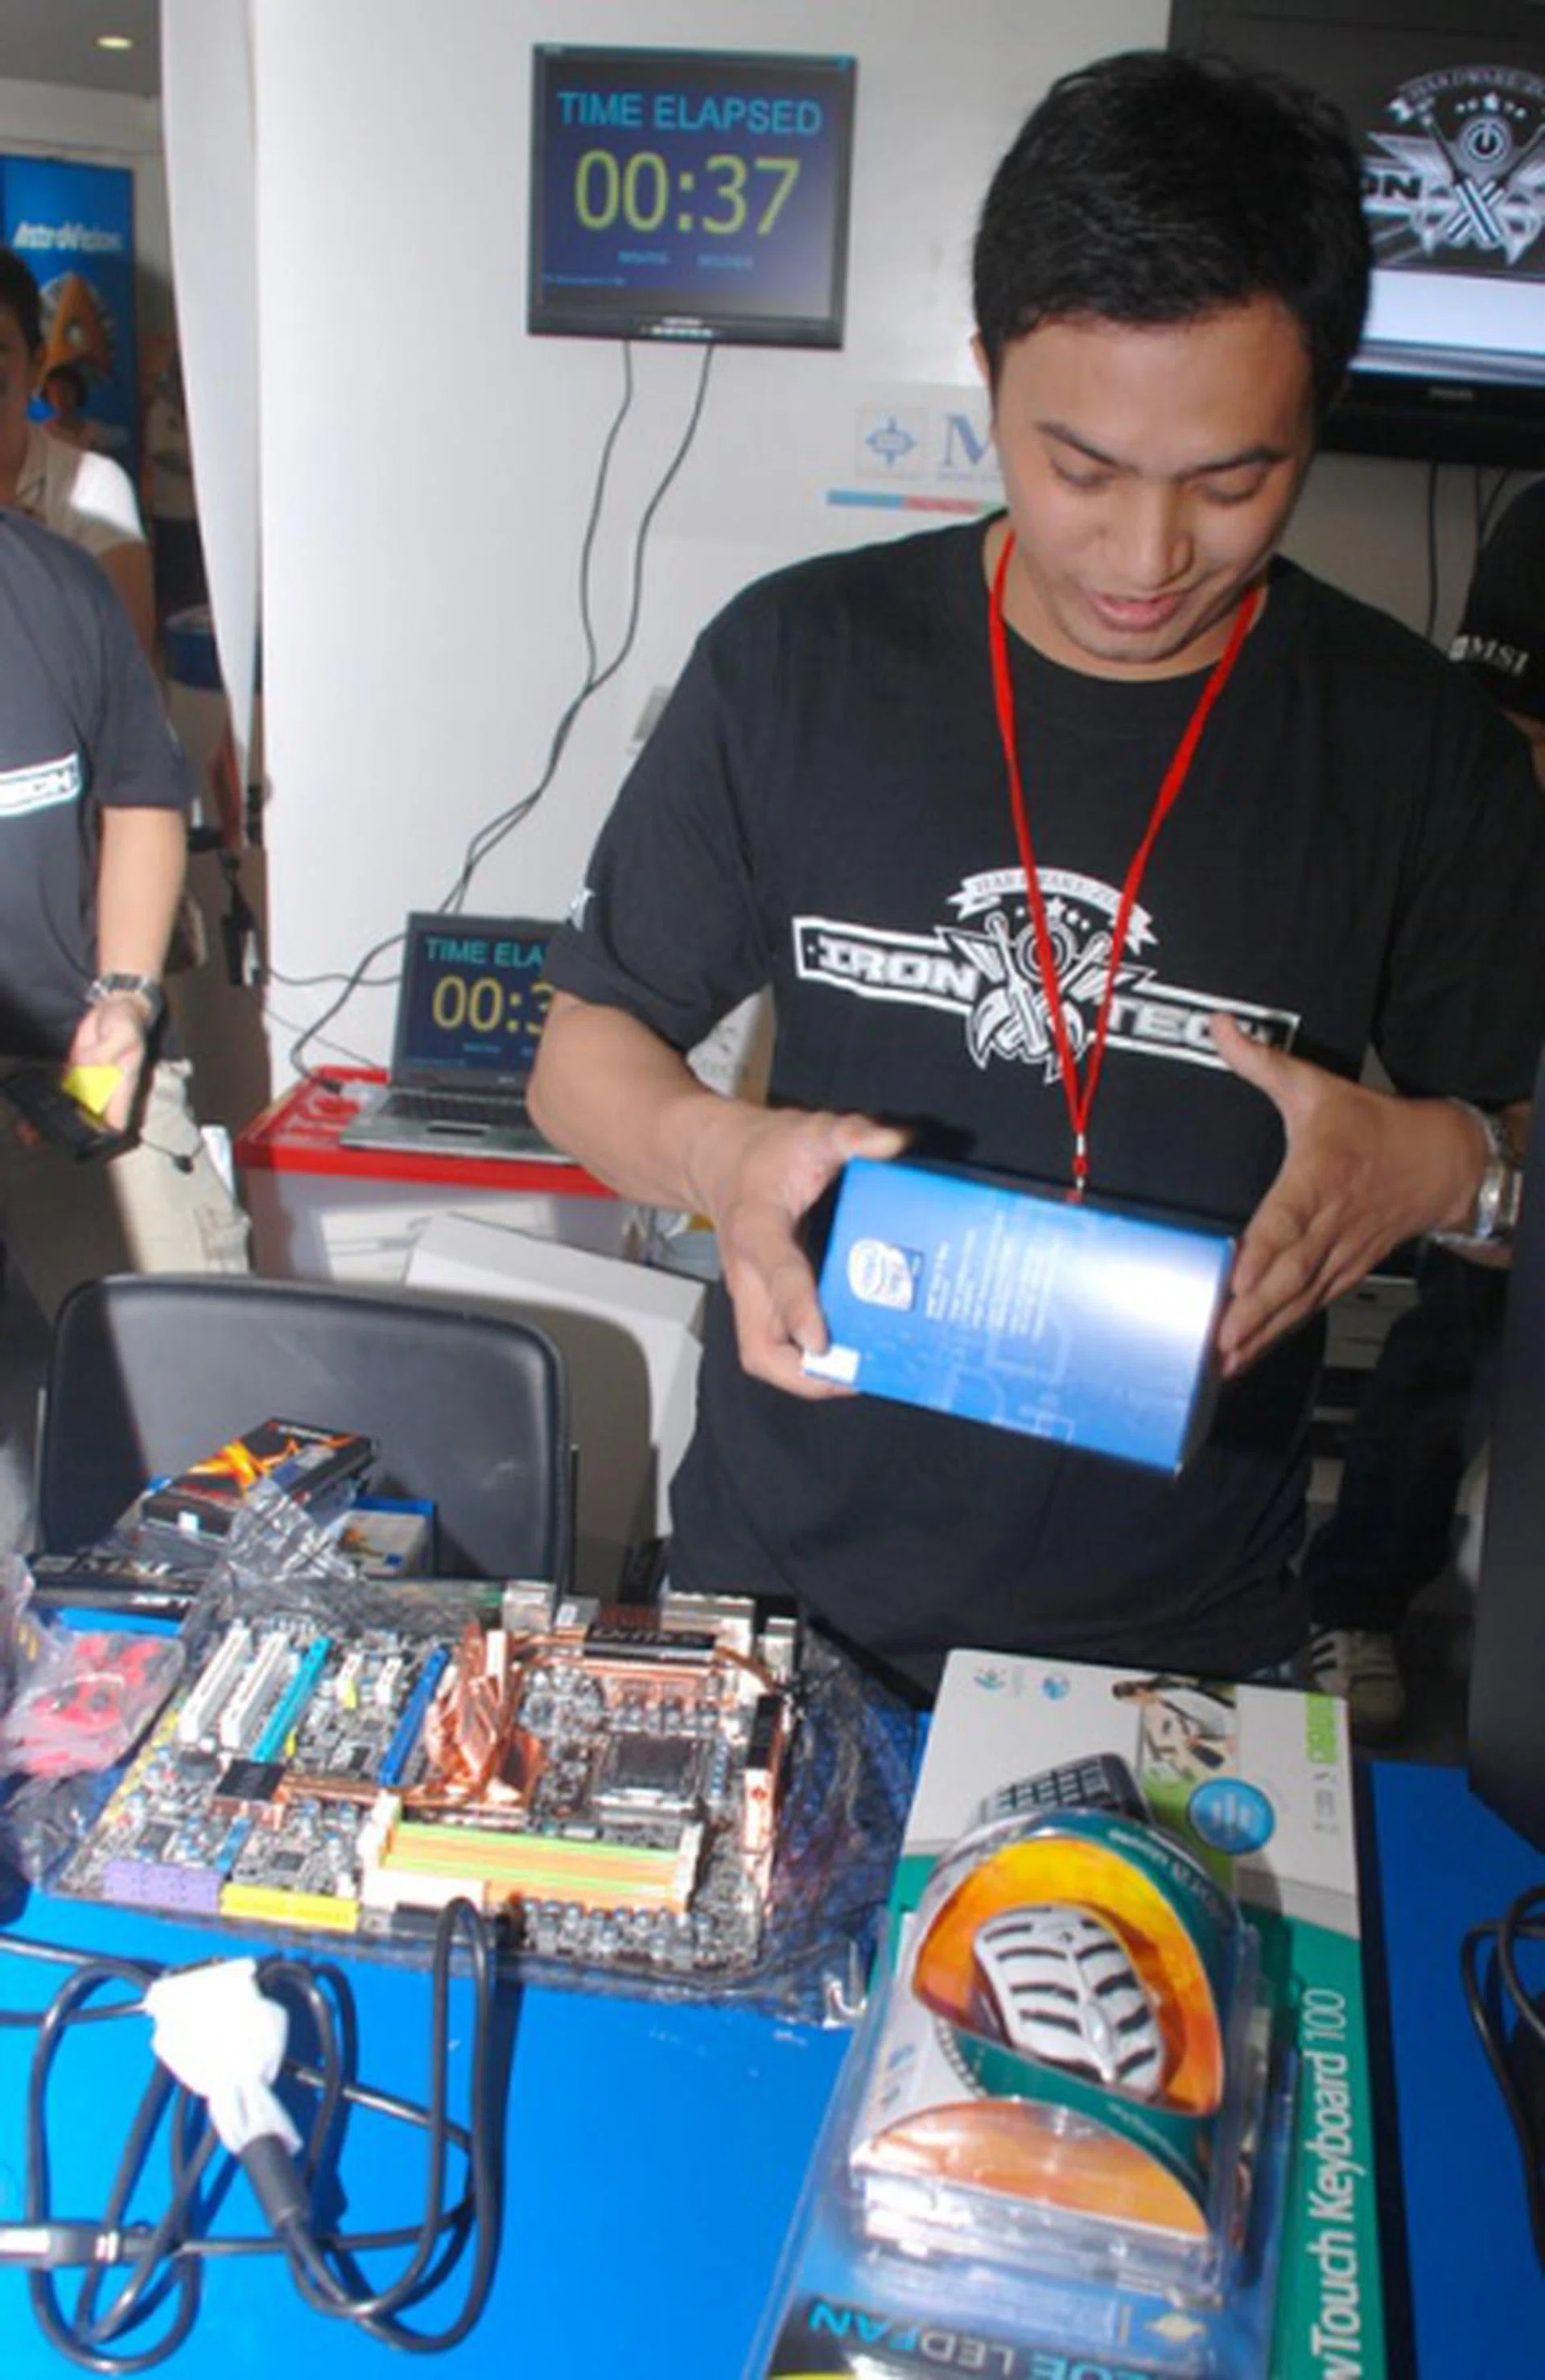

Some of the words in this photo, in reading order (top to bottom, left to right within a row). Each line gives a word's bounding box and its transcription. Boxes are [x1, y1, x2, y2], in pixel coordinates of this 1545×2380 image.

[558, 90, 643, 127] TIME
[653, 93, 823, 136] ELAPSED
[574, 147, 801, 237] 00:37
[1359, 171, 1423, 201] ON
[425, 937, 489, 963] TIME
[493, 941, 544, 967] ELA
[817, 934, 979, 1003] IRON
[431, 973, 554, 1037] 00:3
[1301, 1987, 1347, 2041] 100
[1302, 2048, 1366, 2222] Keyboard
